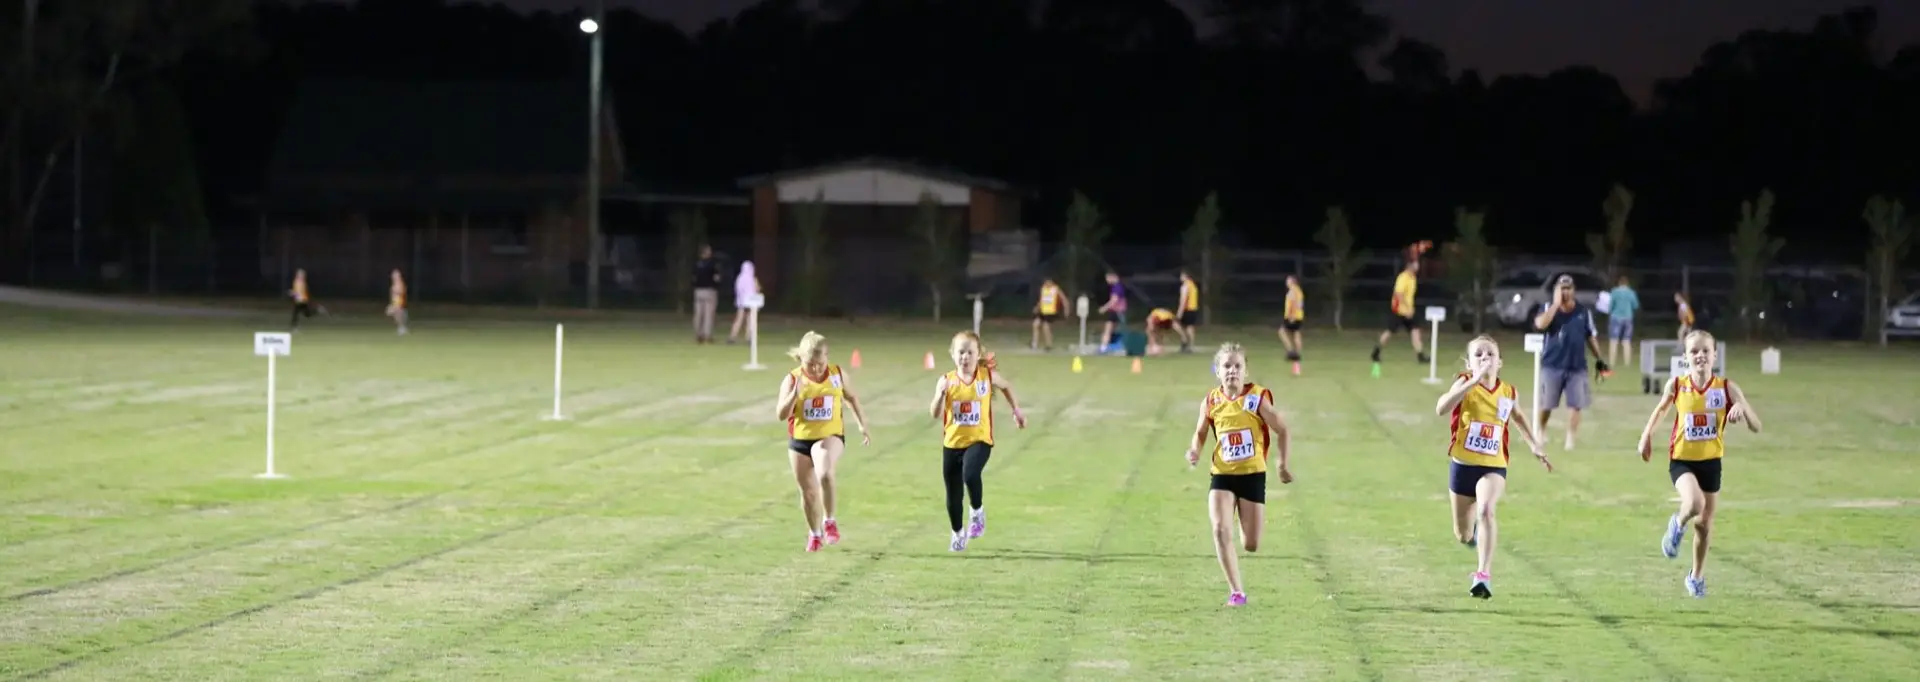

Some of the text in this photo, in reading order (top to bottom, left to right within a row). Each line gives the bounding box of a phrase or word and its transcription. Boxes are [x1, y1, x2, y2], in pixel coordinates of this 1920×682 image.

[1248, 401, 1254, 410] 9
[1686, 426, 1717, 437] 15244
[1468, 435, 1500, 451] 15306
